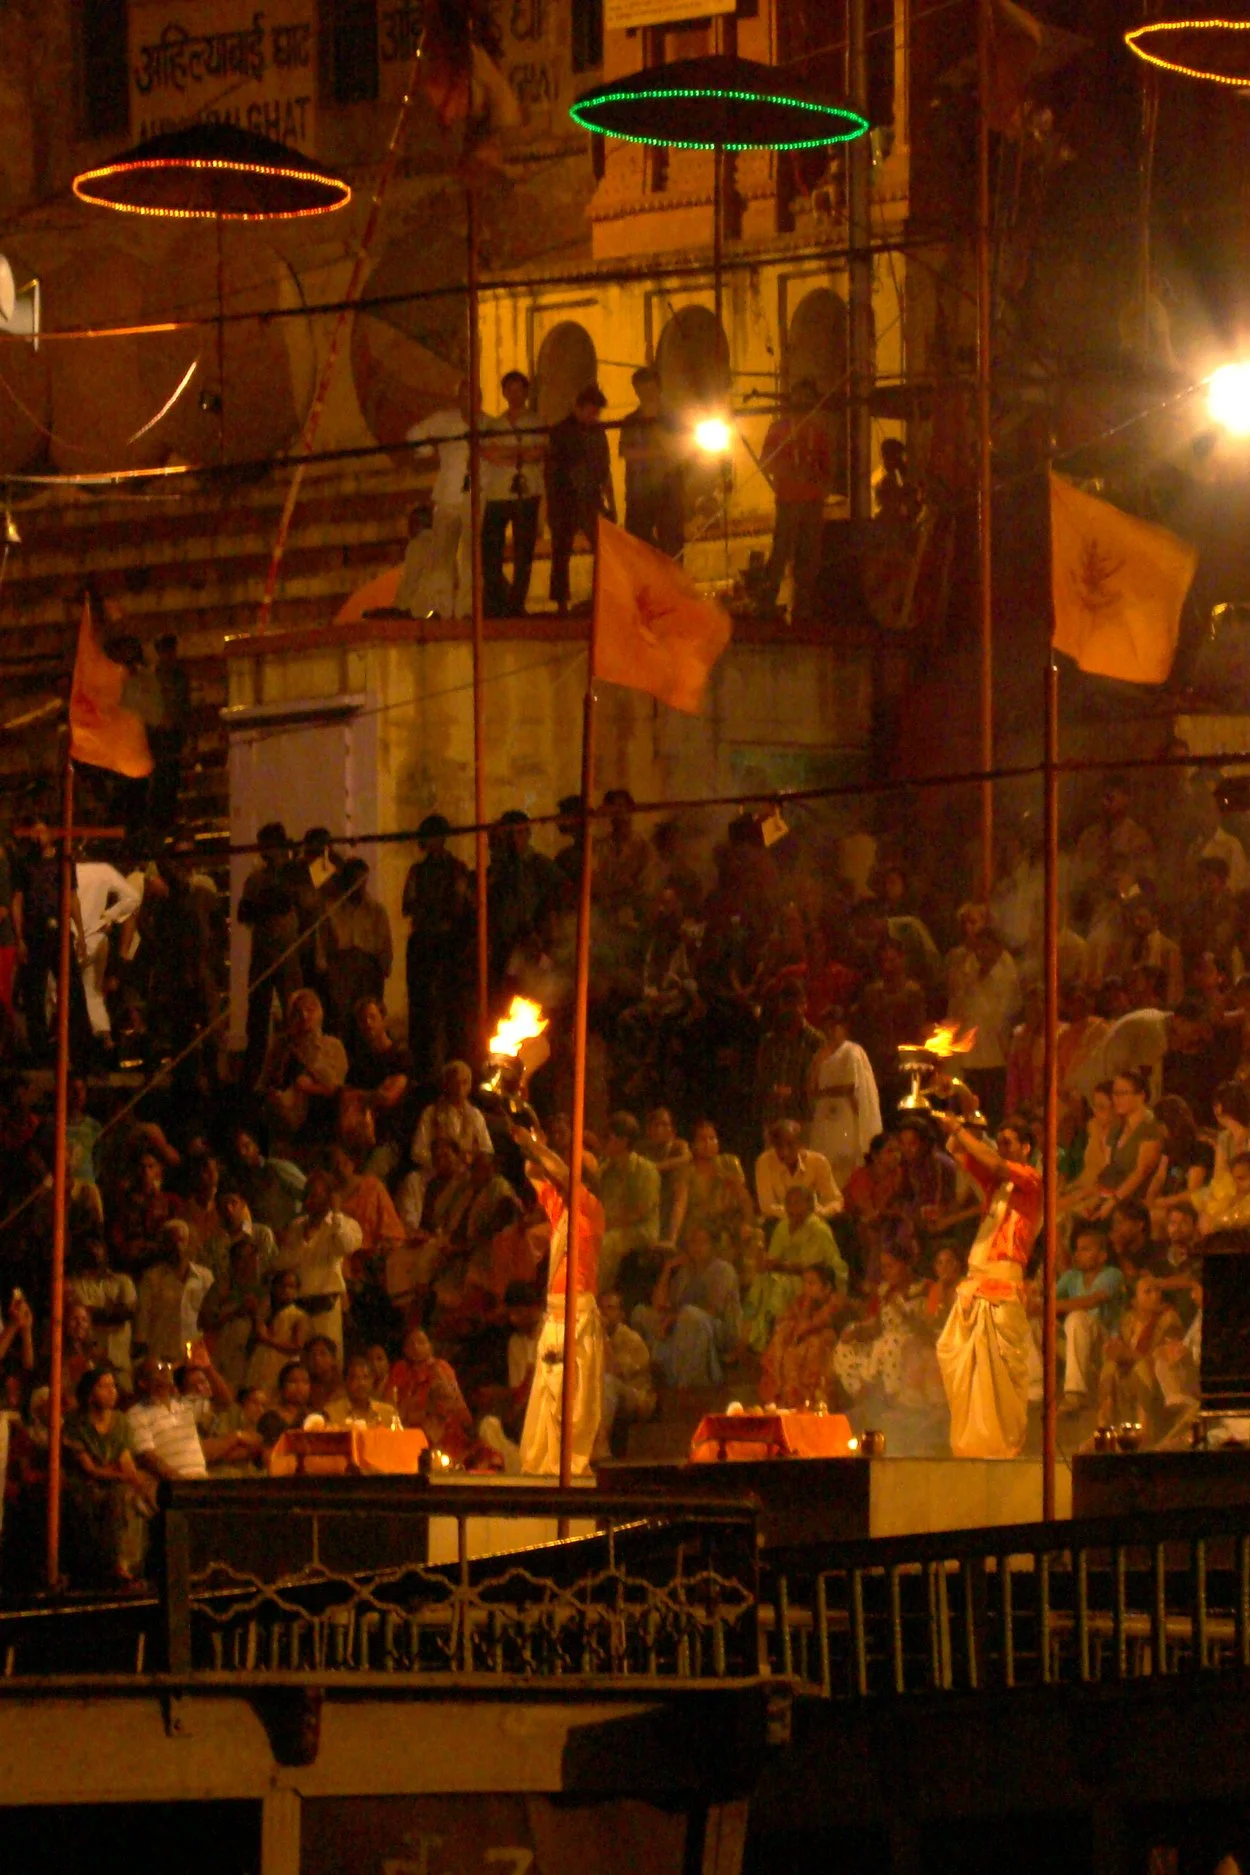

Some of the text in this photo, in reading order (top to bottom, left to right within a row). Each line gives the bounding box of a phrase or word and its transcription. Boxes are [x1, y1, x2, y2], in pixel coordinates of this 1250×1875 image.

[135, 11, 266, 92] अहिल्याबाई
[271, 24, 310, 67] घाट
[246, 95, 311, 143] GHAT
